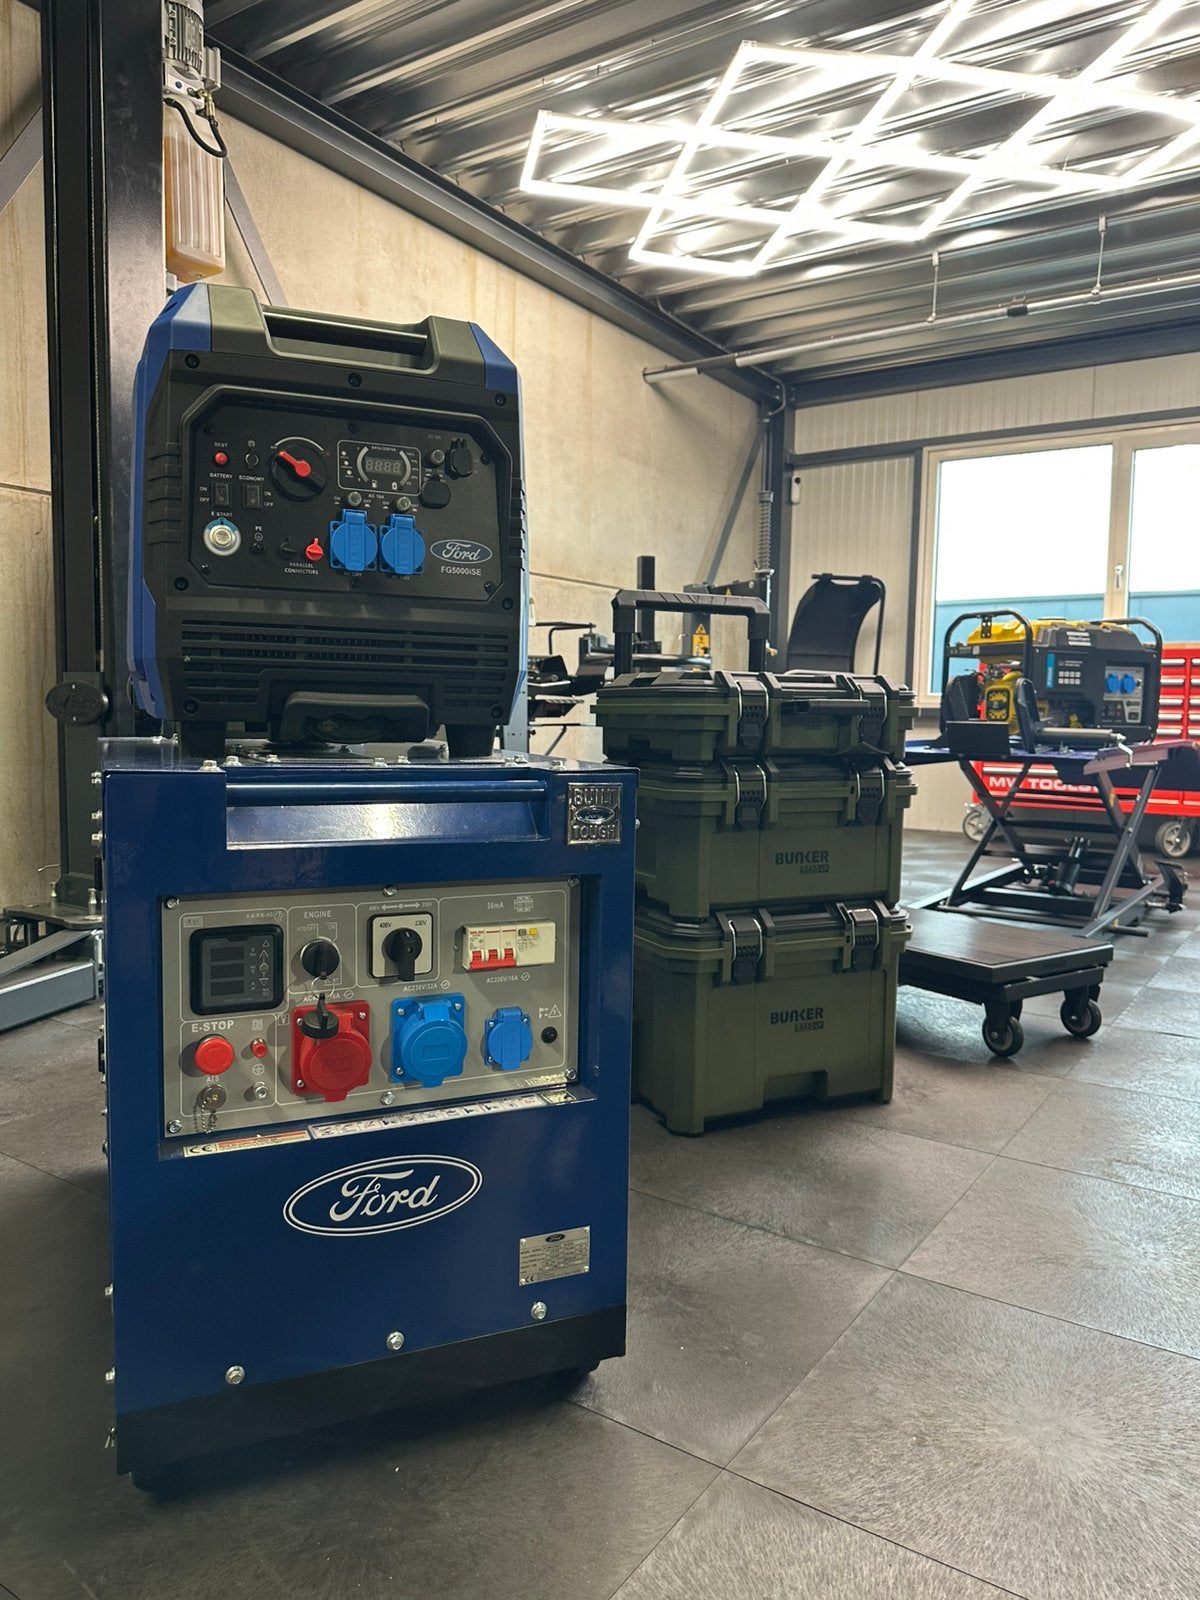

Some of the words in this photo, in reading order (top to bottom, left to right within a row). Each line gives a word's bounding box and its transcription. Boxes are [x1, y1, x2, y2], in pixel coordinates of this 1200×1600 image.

[209, 472, 233, 480] BATTERY
[442, 541, 480, 561] Ford
[440, 565, 482, 576] FG5000iSE
[574, 788, 616, 805] BUILT
[572, 824, 616, 838] TOUGH
[775, 850, 829, 865] BUNKER
[303, 910, 332, 919] ENGINE
[770, 1007, 824, 1025] BUNKER
[191, 1020, 234, 1033] E-STOP
[329, 1169, 441, 1222] Ford
